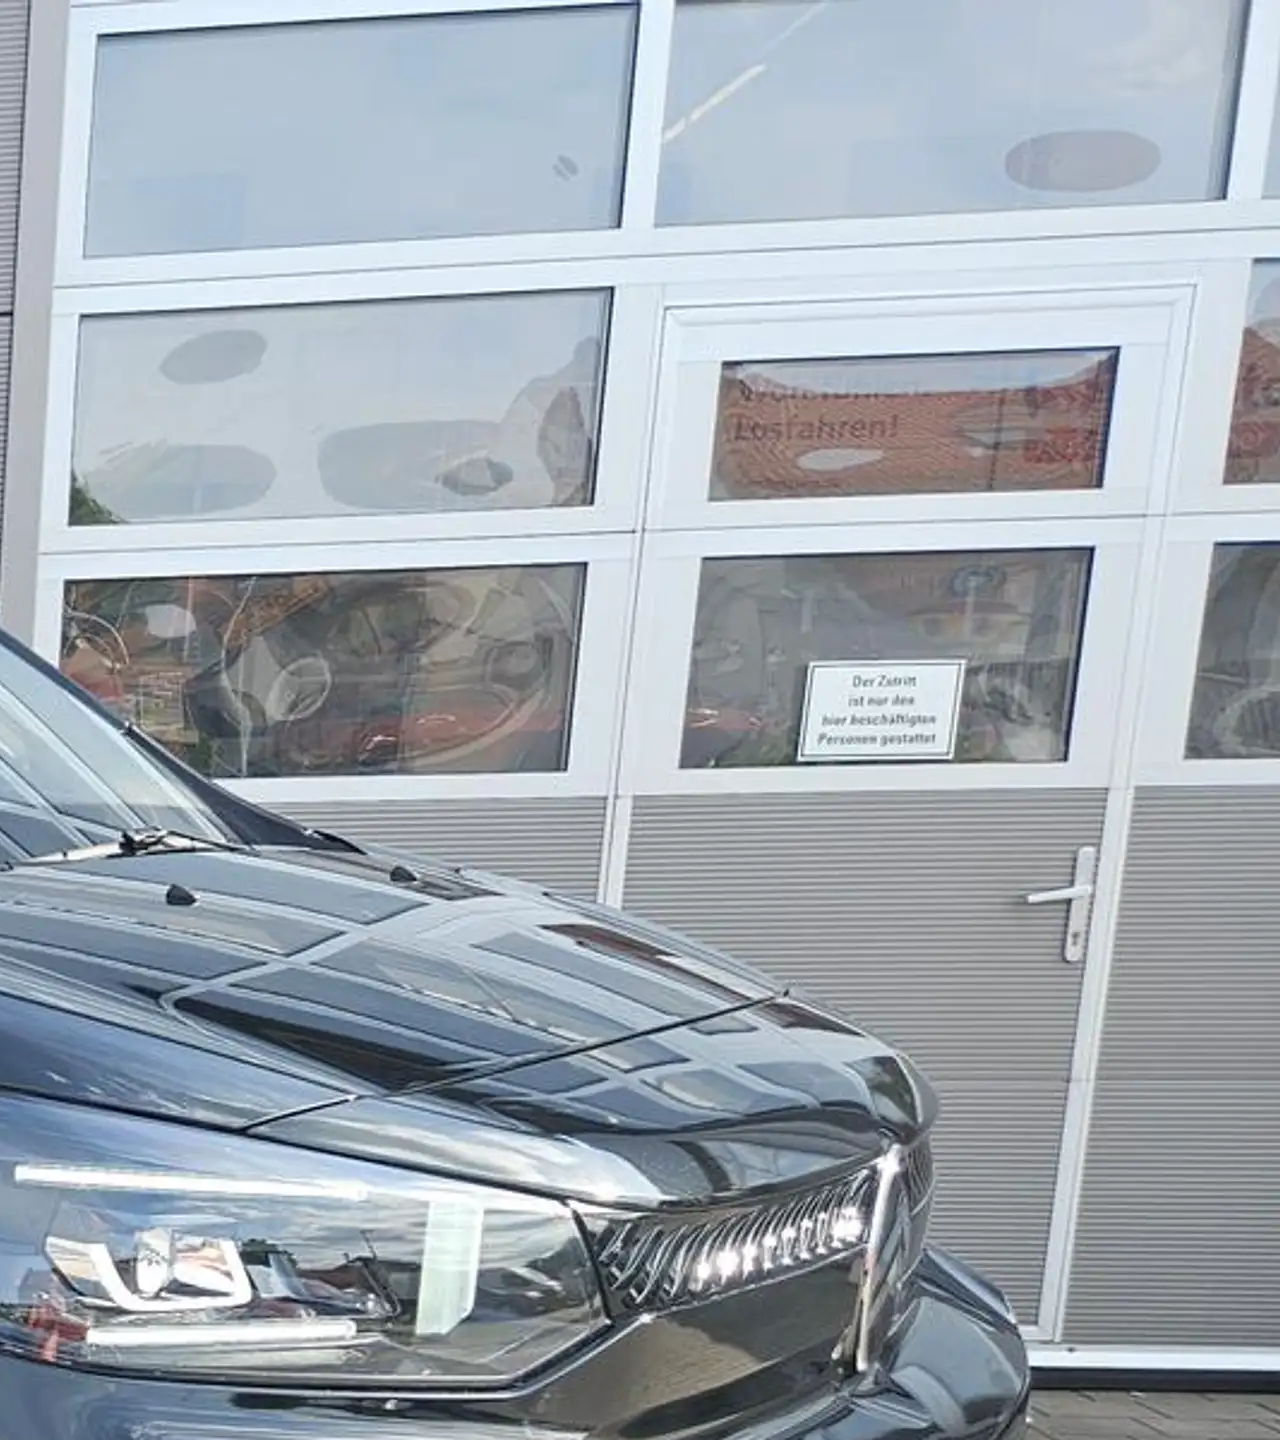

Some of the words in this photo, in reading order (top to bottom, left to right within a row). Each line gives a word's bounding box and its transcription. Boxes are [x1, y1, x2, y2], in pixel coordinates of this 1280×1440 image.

[852, 674, 874, 688] Der
[877, 674, 917, 688] Zutritt
[848, 695, 864, 707] ist
[867, 697, 888, 707] nur
[891, 694, 915, 707] den
[821, 713, 847, 727] hier
[849, 712, 937, 728] beschäftigten
[817, 733, 877, 746] Personen
[879, 732, 937, 747] gestattet
